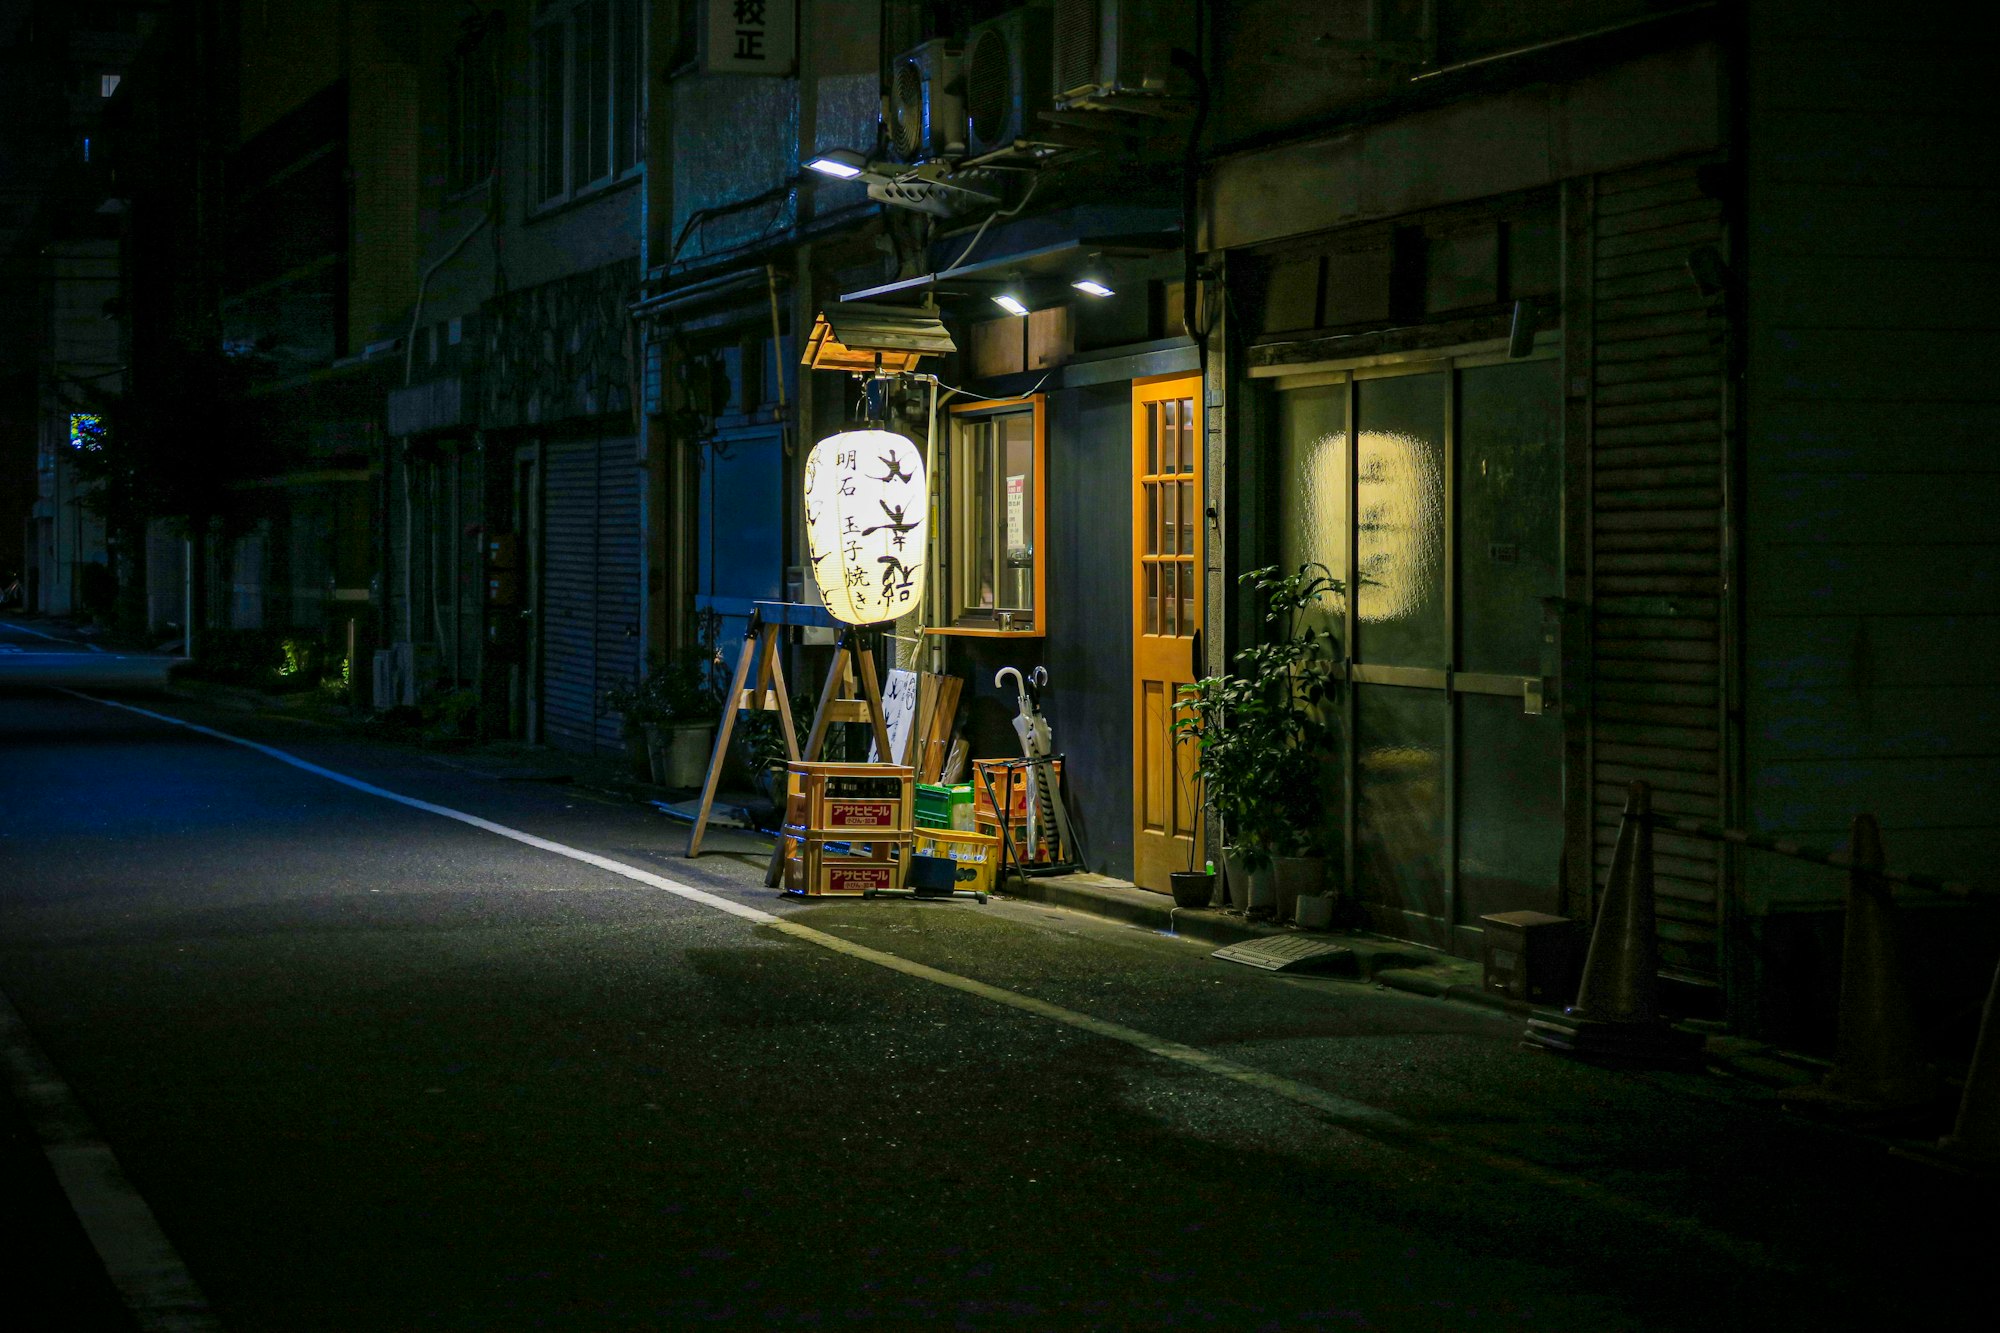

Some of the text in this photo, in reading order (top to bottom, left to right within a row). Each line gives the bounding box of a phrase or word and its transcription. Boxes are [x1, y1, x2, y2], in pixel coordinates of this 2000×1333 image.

[733, 0, 765, 60] 校正
[836, 450, 871, 610] 明石 玉子焼き
[833, 805, 890, 816] アサヒビール
[832, 870, 889, 881] アサヒビール
